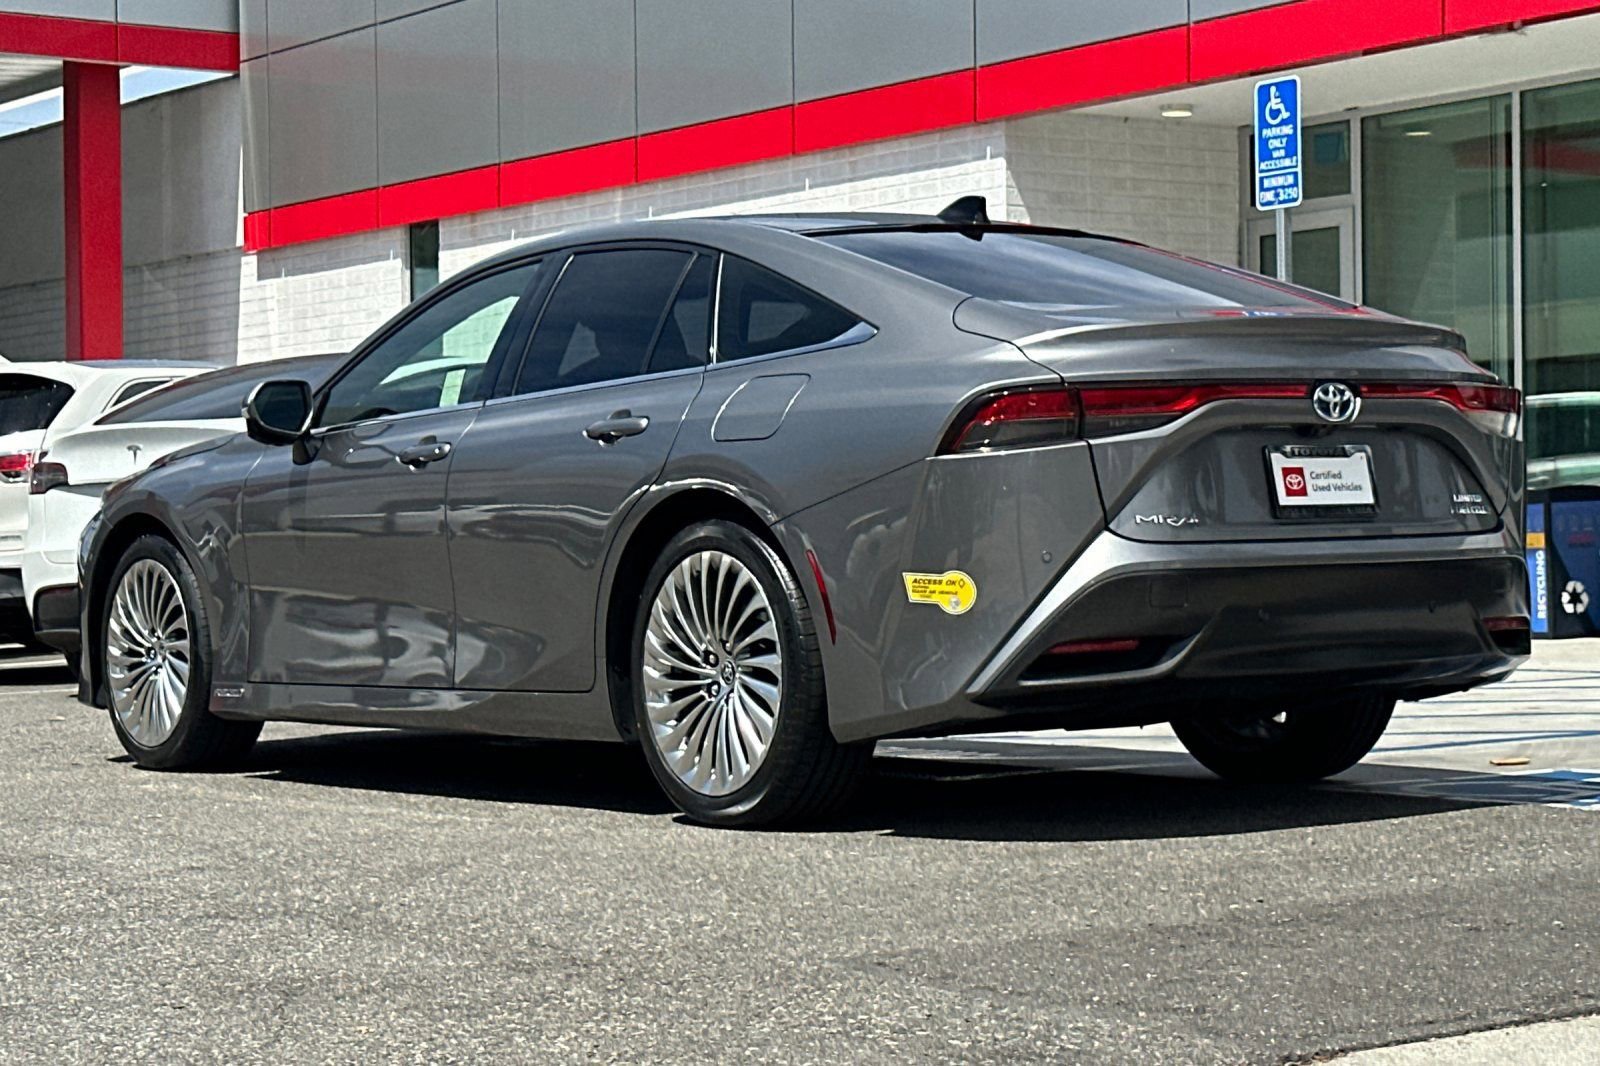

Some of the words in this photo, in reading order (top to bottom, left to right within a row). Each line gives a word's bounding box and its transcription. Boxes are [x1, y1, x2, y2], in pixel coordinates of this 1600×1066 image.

[1262, 124, 1293, 138] PARKING
[1268, 137, 1287, 150] ONLY
[1292, 447, 1343, 456] TOYOTA
[1310, 470, 1342, 480] Certified
[1312, 483, 1331, 492] Used
[1333, 482, 1362, 491] Vehicles
[1536, 550, 1547, 619] RECYCLING
